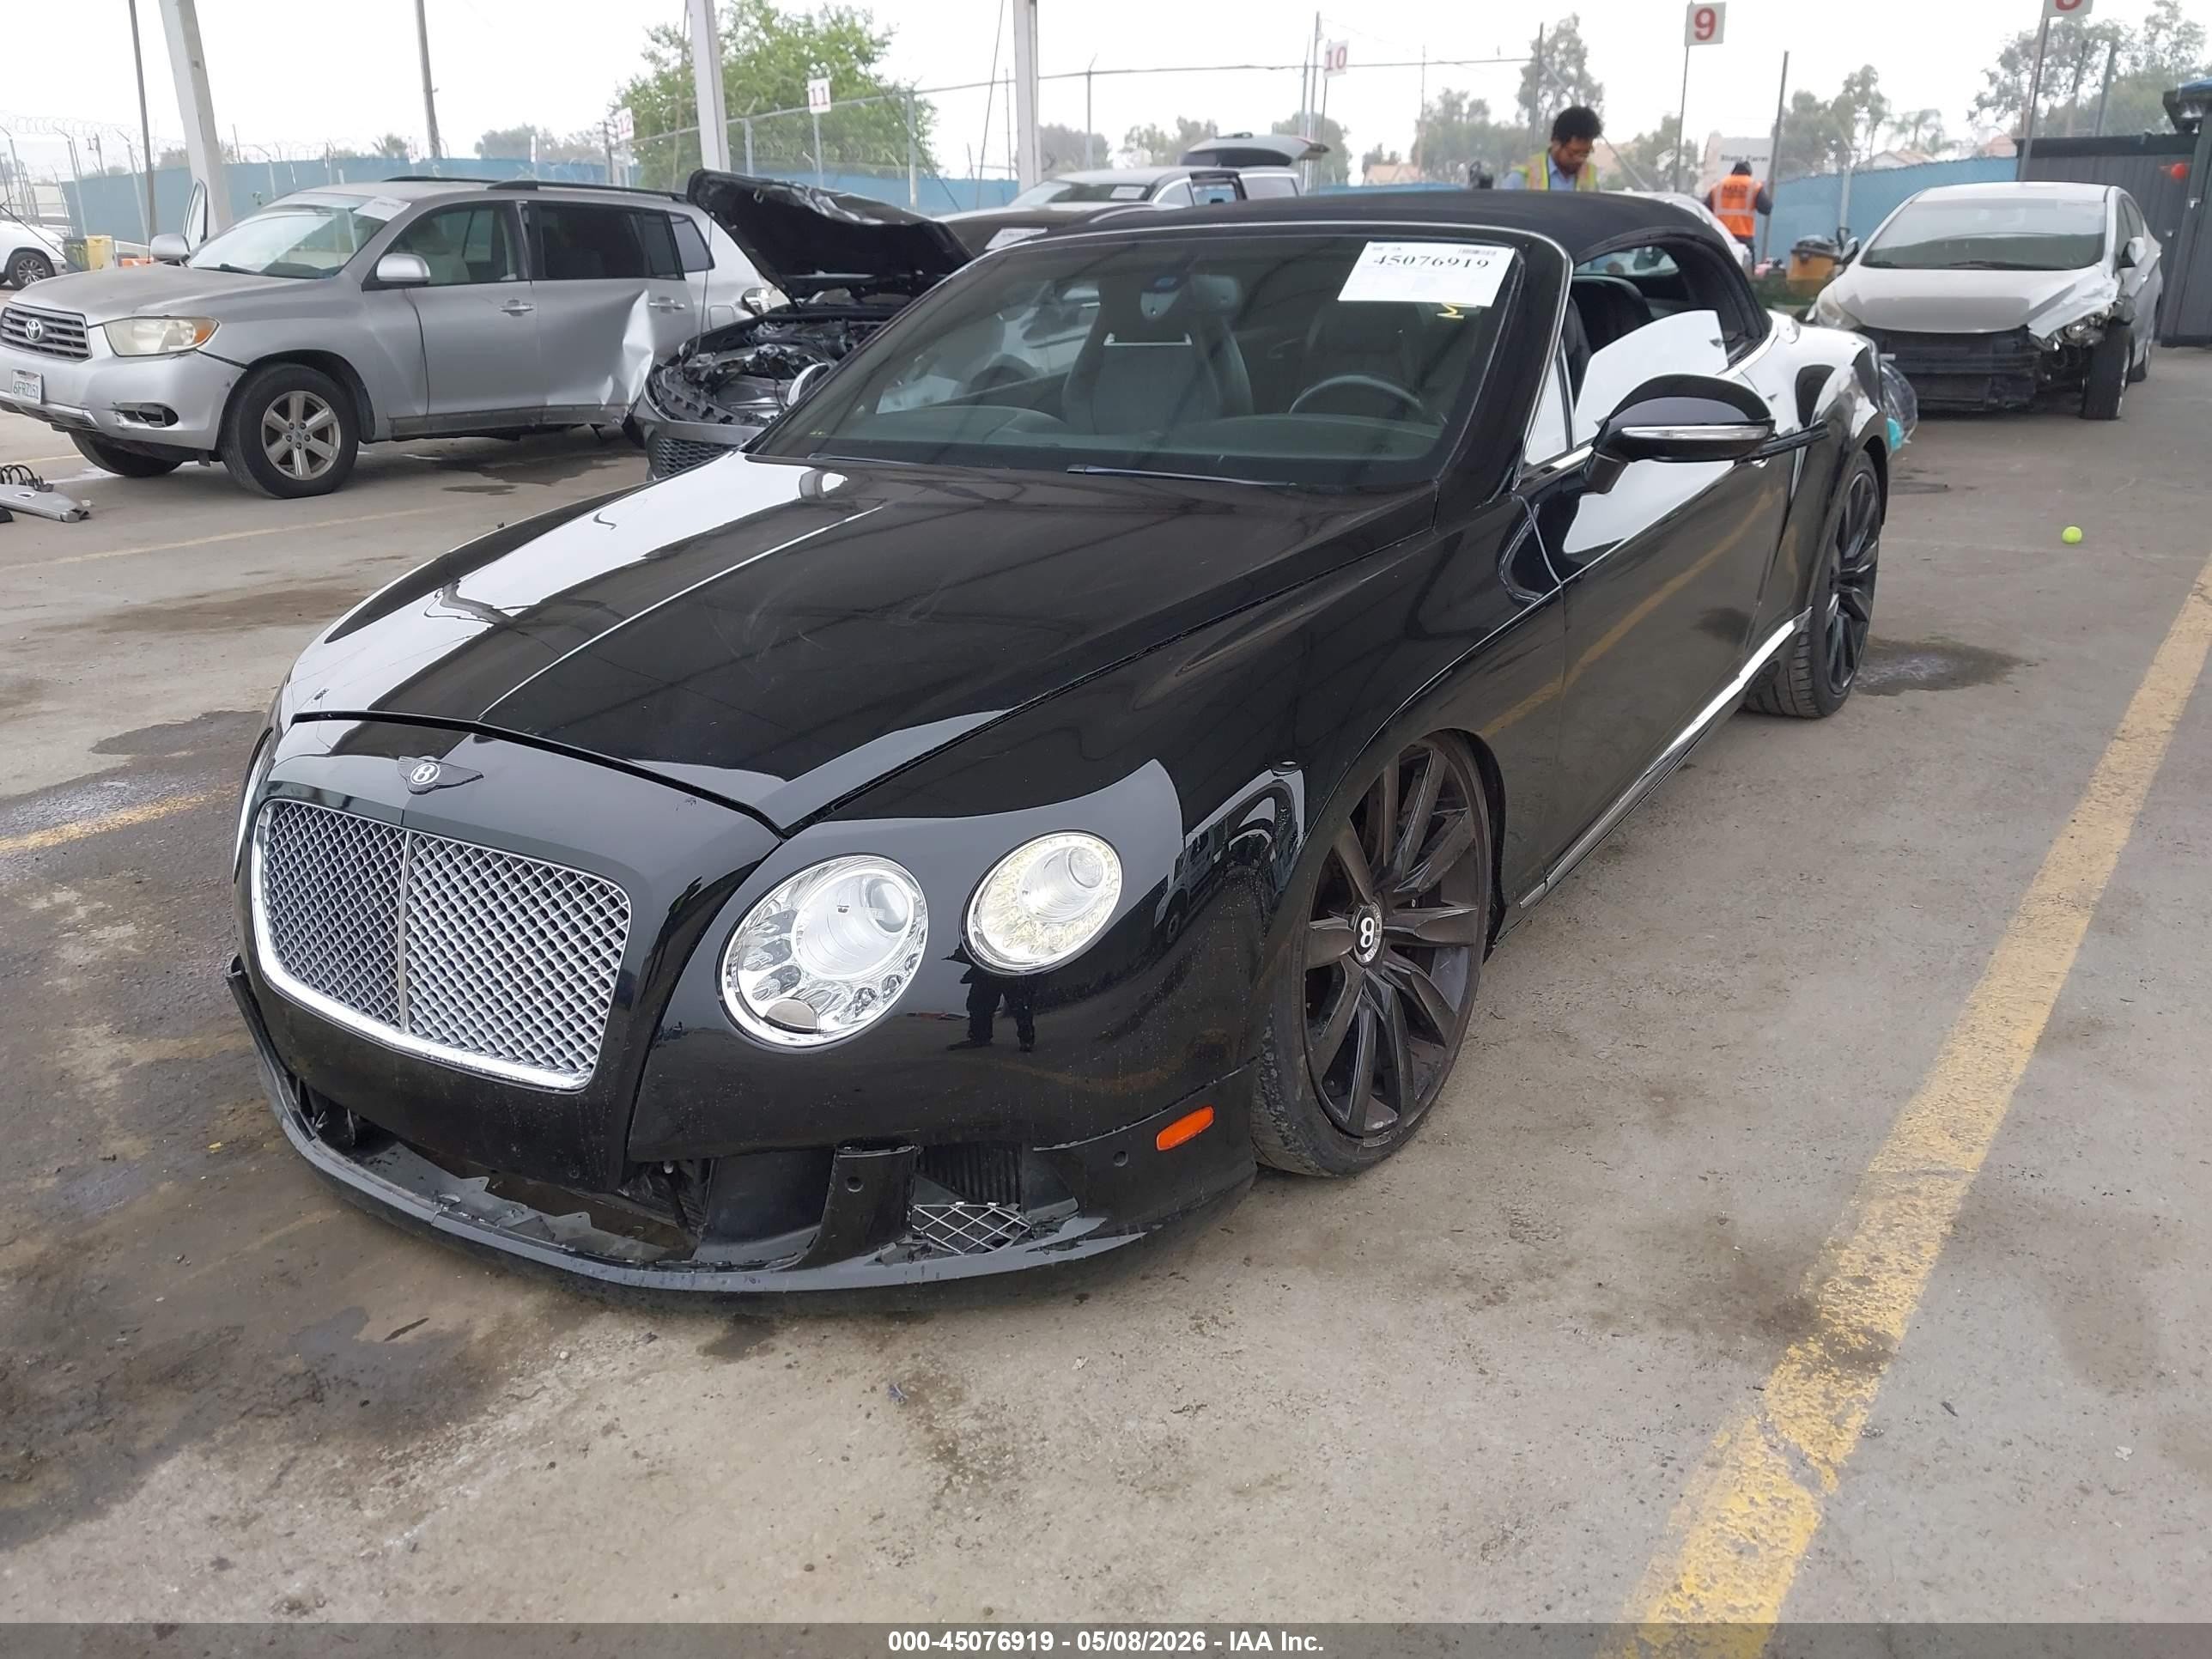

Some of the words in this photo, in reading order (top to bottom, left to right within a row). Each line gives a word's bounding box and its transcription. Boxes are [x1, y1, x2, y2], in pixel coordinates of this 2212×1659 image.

[1694, 7, 1717, 40] 9
[1324, 46, 1347, 71] 10
[811, 86, 828, 106] 11
[619, 114, 632, 134] 12
[1373, 253, 1490, 269] 45076919
